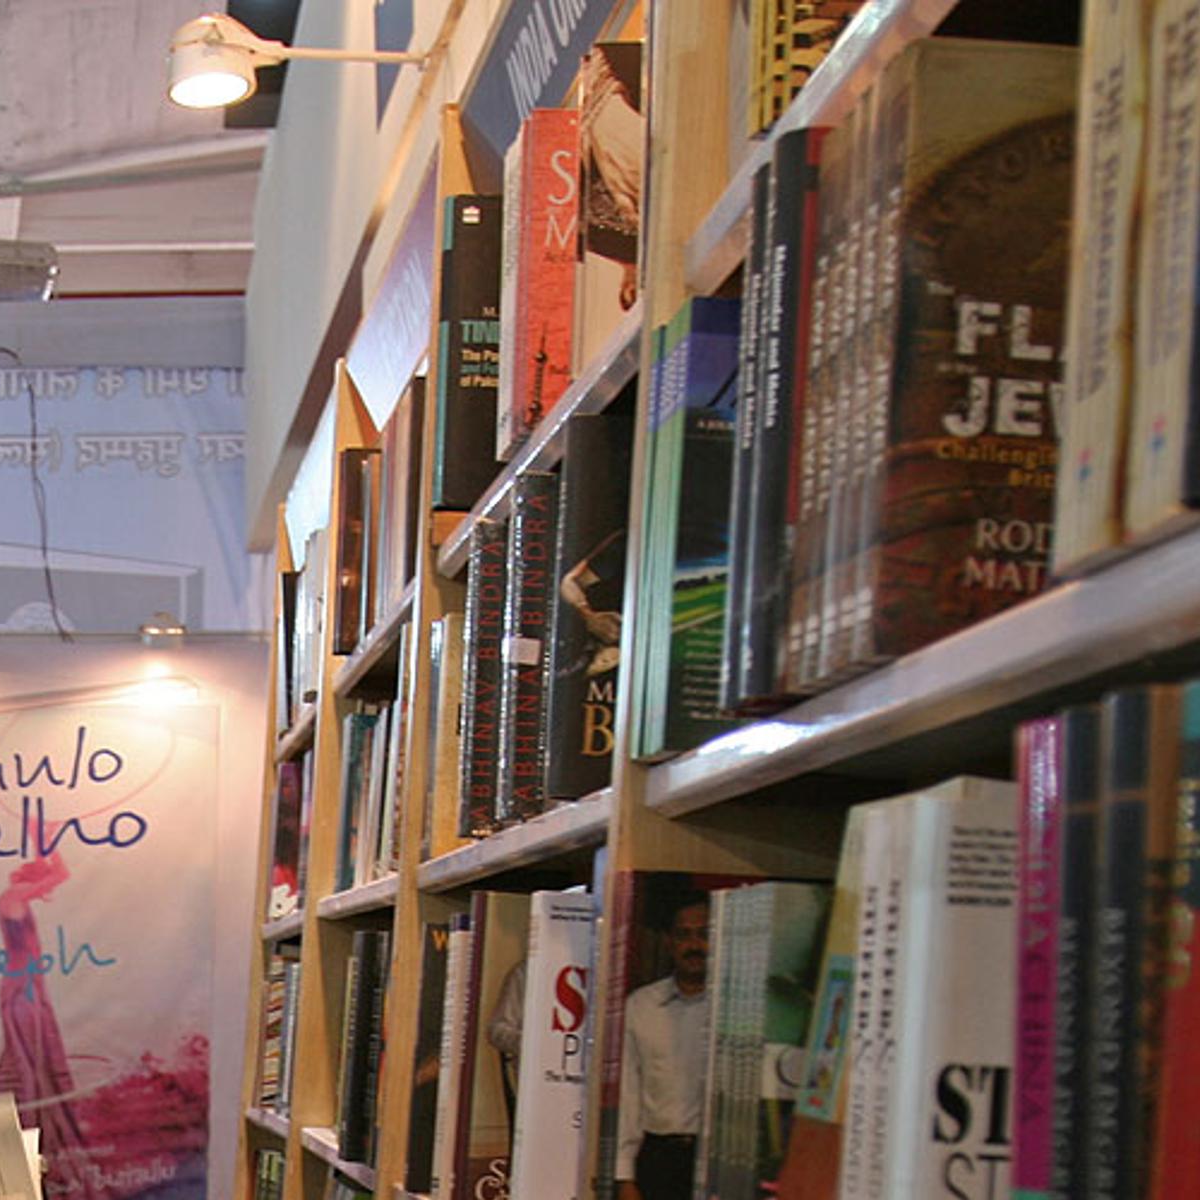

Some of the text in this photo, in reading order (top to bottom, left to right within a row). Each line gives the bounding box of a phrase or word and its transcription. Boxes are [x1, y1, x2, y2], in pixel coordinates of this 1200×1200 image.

[955, 300, 1066, 361] FL
[469, 540, 506, 825] ABHINAV BINDRA
[513, 492, 551, 804] ABHINA BINDRA
